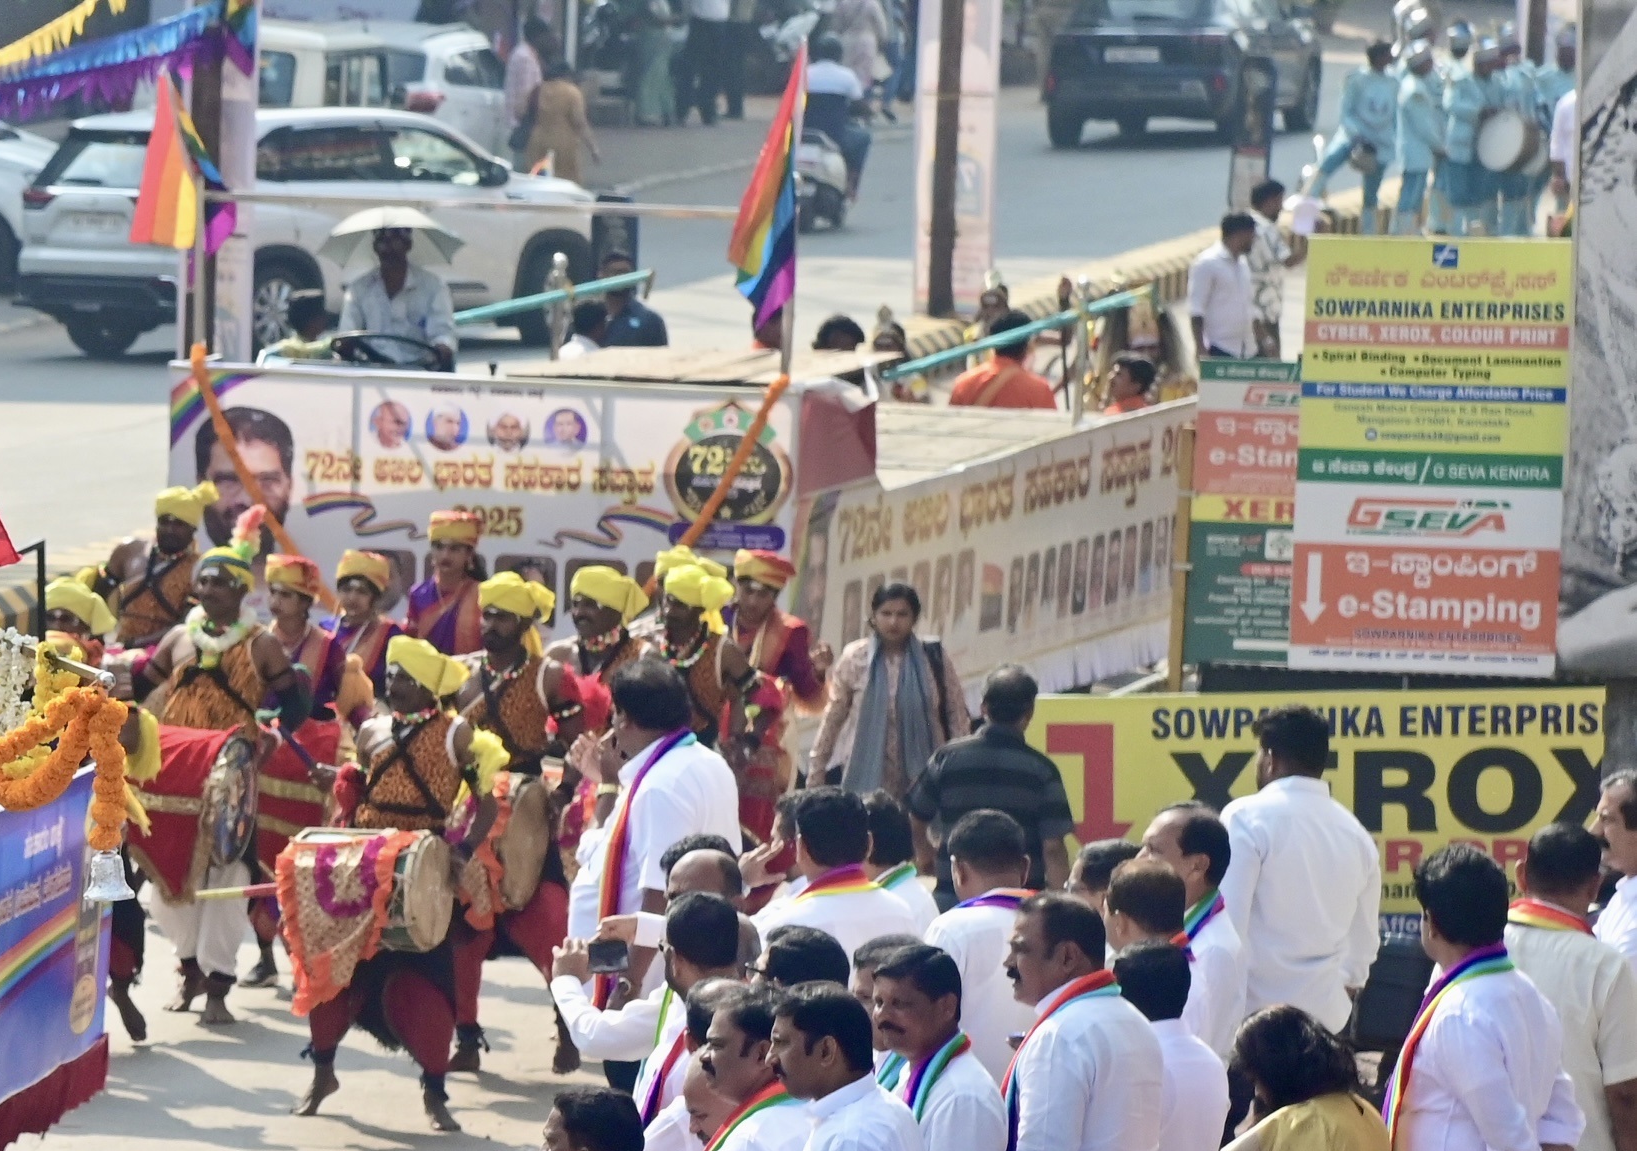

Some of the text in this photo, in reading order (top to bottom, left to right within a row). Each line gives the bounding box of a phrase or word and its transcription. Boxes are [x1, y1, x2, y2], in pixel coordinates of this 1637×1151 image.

[1314, 299, 1565, 321] SOWPARNIKA ENTERPRISES
[1317, 324, 1374, 341] CYBER,
[1441, 326, 1504, 342] COLOUR
[1510, 327, 1557, 343] PRINT
[1322, 352, 1406, 365] Spiral Binding
[1422, 355, 1482, 366] Document
[1389, 367, 1492, 381] Computer Typing
[1316, 385, 1554, 401] For Student We Charge Affordable Price
[1448, 464, 1486, 480] SEVA
[1489, 465, 1550, 481] KENDRA
[1337, 589, 1541, 630] e-Stamping
[1152, 703, 1605, 740] SOWPIKA ENTERPRIS
[1171, 747, 1604, 833] XROX
